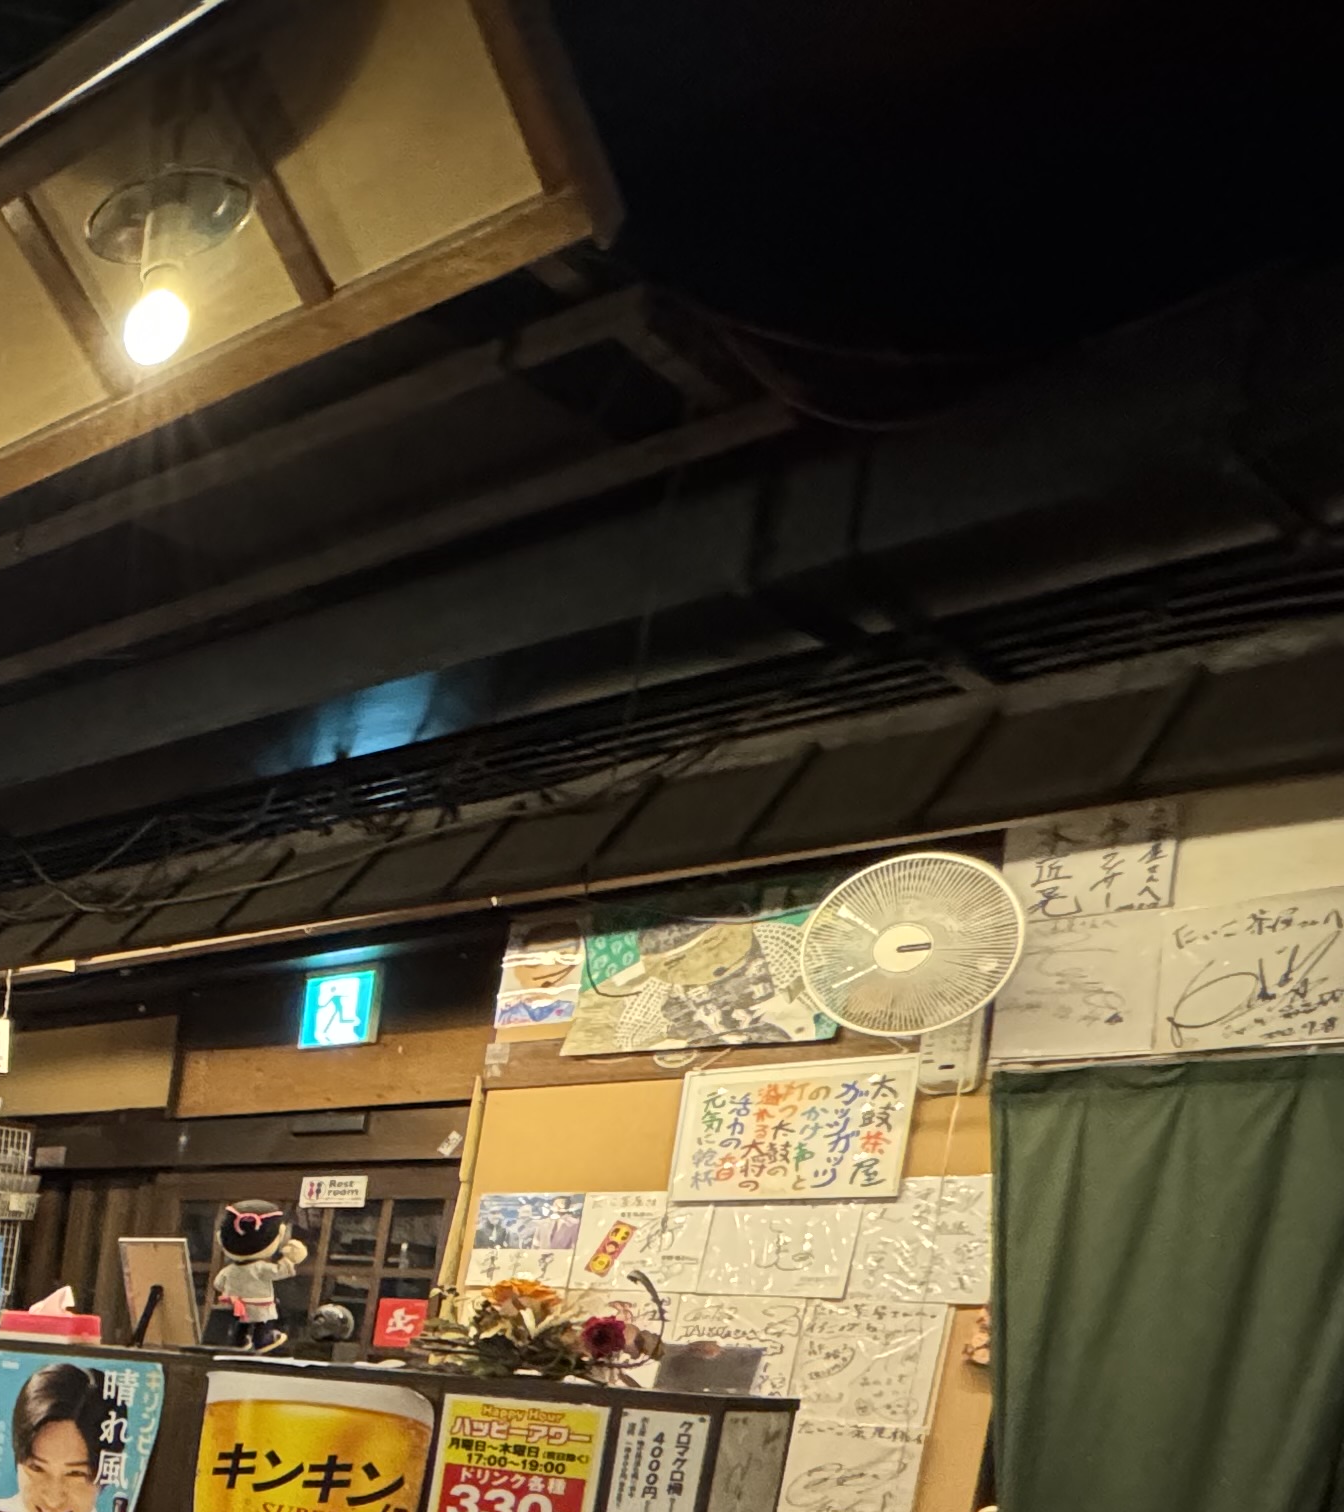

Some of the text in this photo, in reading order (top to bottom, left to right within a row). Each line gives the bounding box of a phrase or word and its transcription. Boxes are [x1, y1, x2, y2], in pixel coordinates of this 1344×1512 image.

[328, 1179, 354, 1188] Rest
[328, 1187, 359, 1196] room
[481, 1403, 565, 1424] Happy Hour
[93, 1368, 139, 1489] 晴れ風
[450, 1416, 593, 1446] ハッピーアワー
[460, 1467, 567, 1496] ドリンク各種
